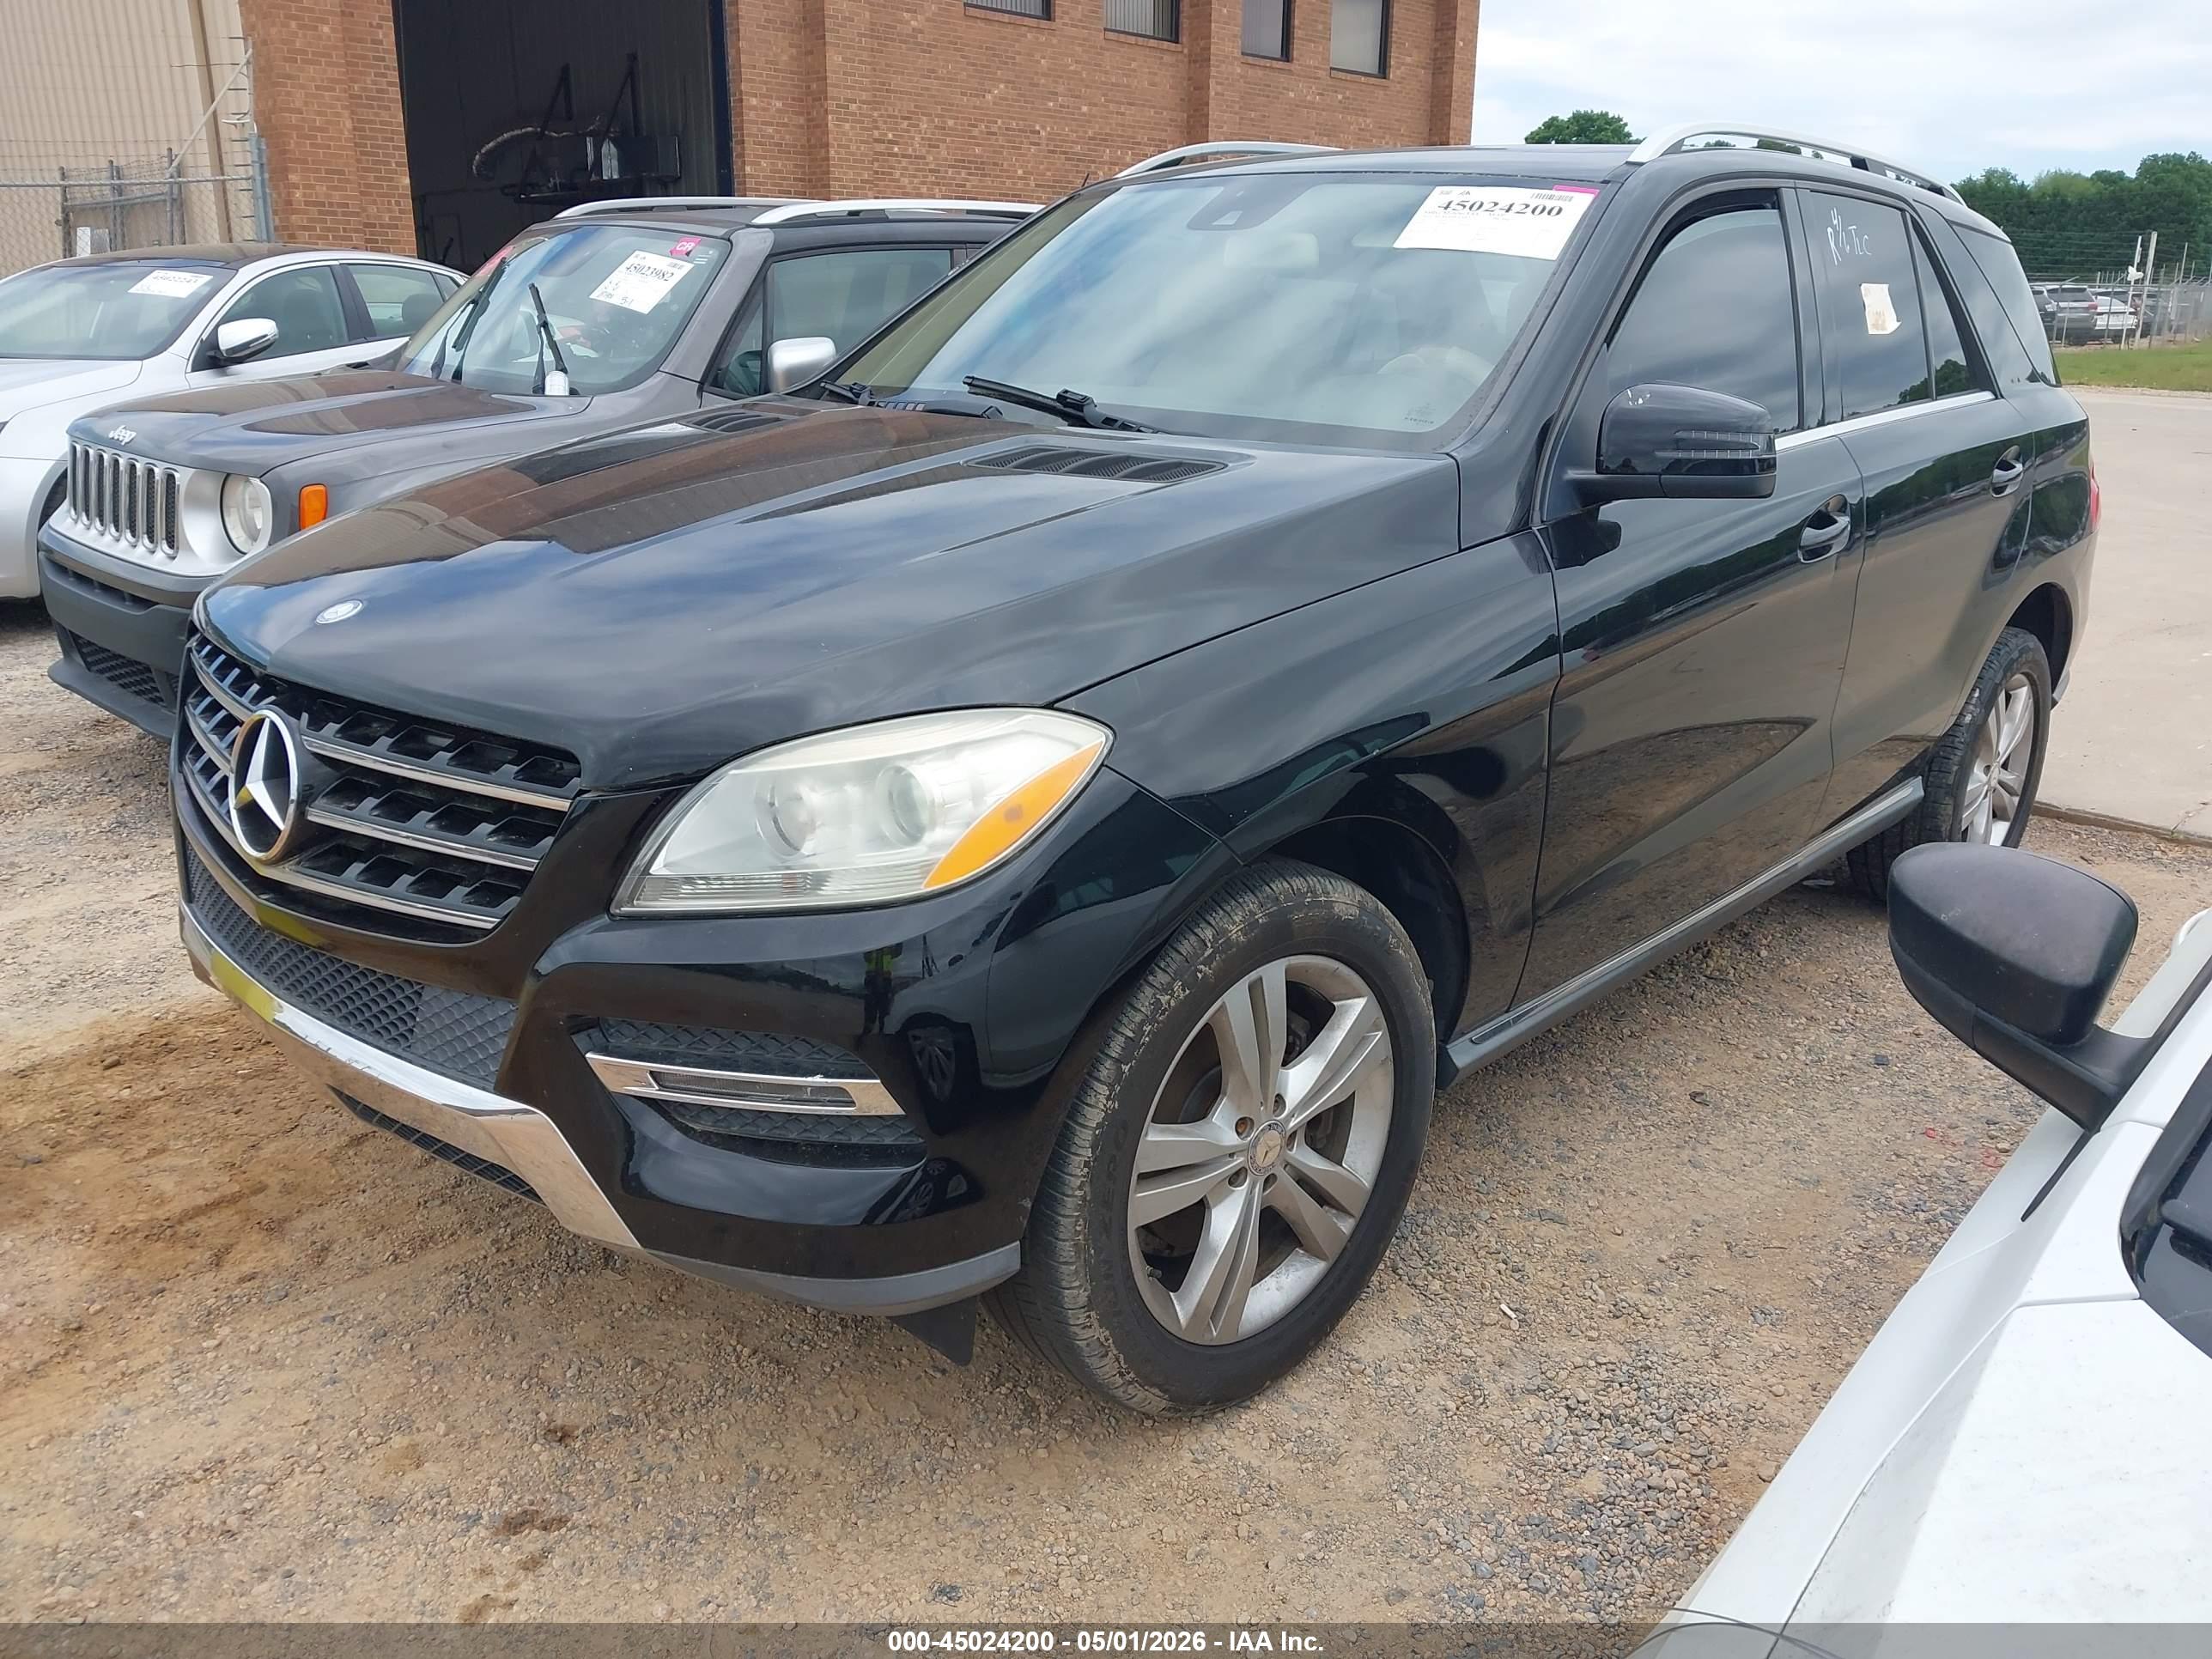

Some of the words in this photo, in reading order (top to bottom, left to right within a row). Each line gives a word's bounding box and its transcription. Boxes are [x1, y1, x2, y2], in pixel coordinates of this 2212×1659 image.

[1437, 199, 1564, 217] 45024200
[625, 262, 675, 282] 45023982
[108, 425, 137, 446] Jeep
